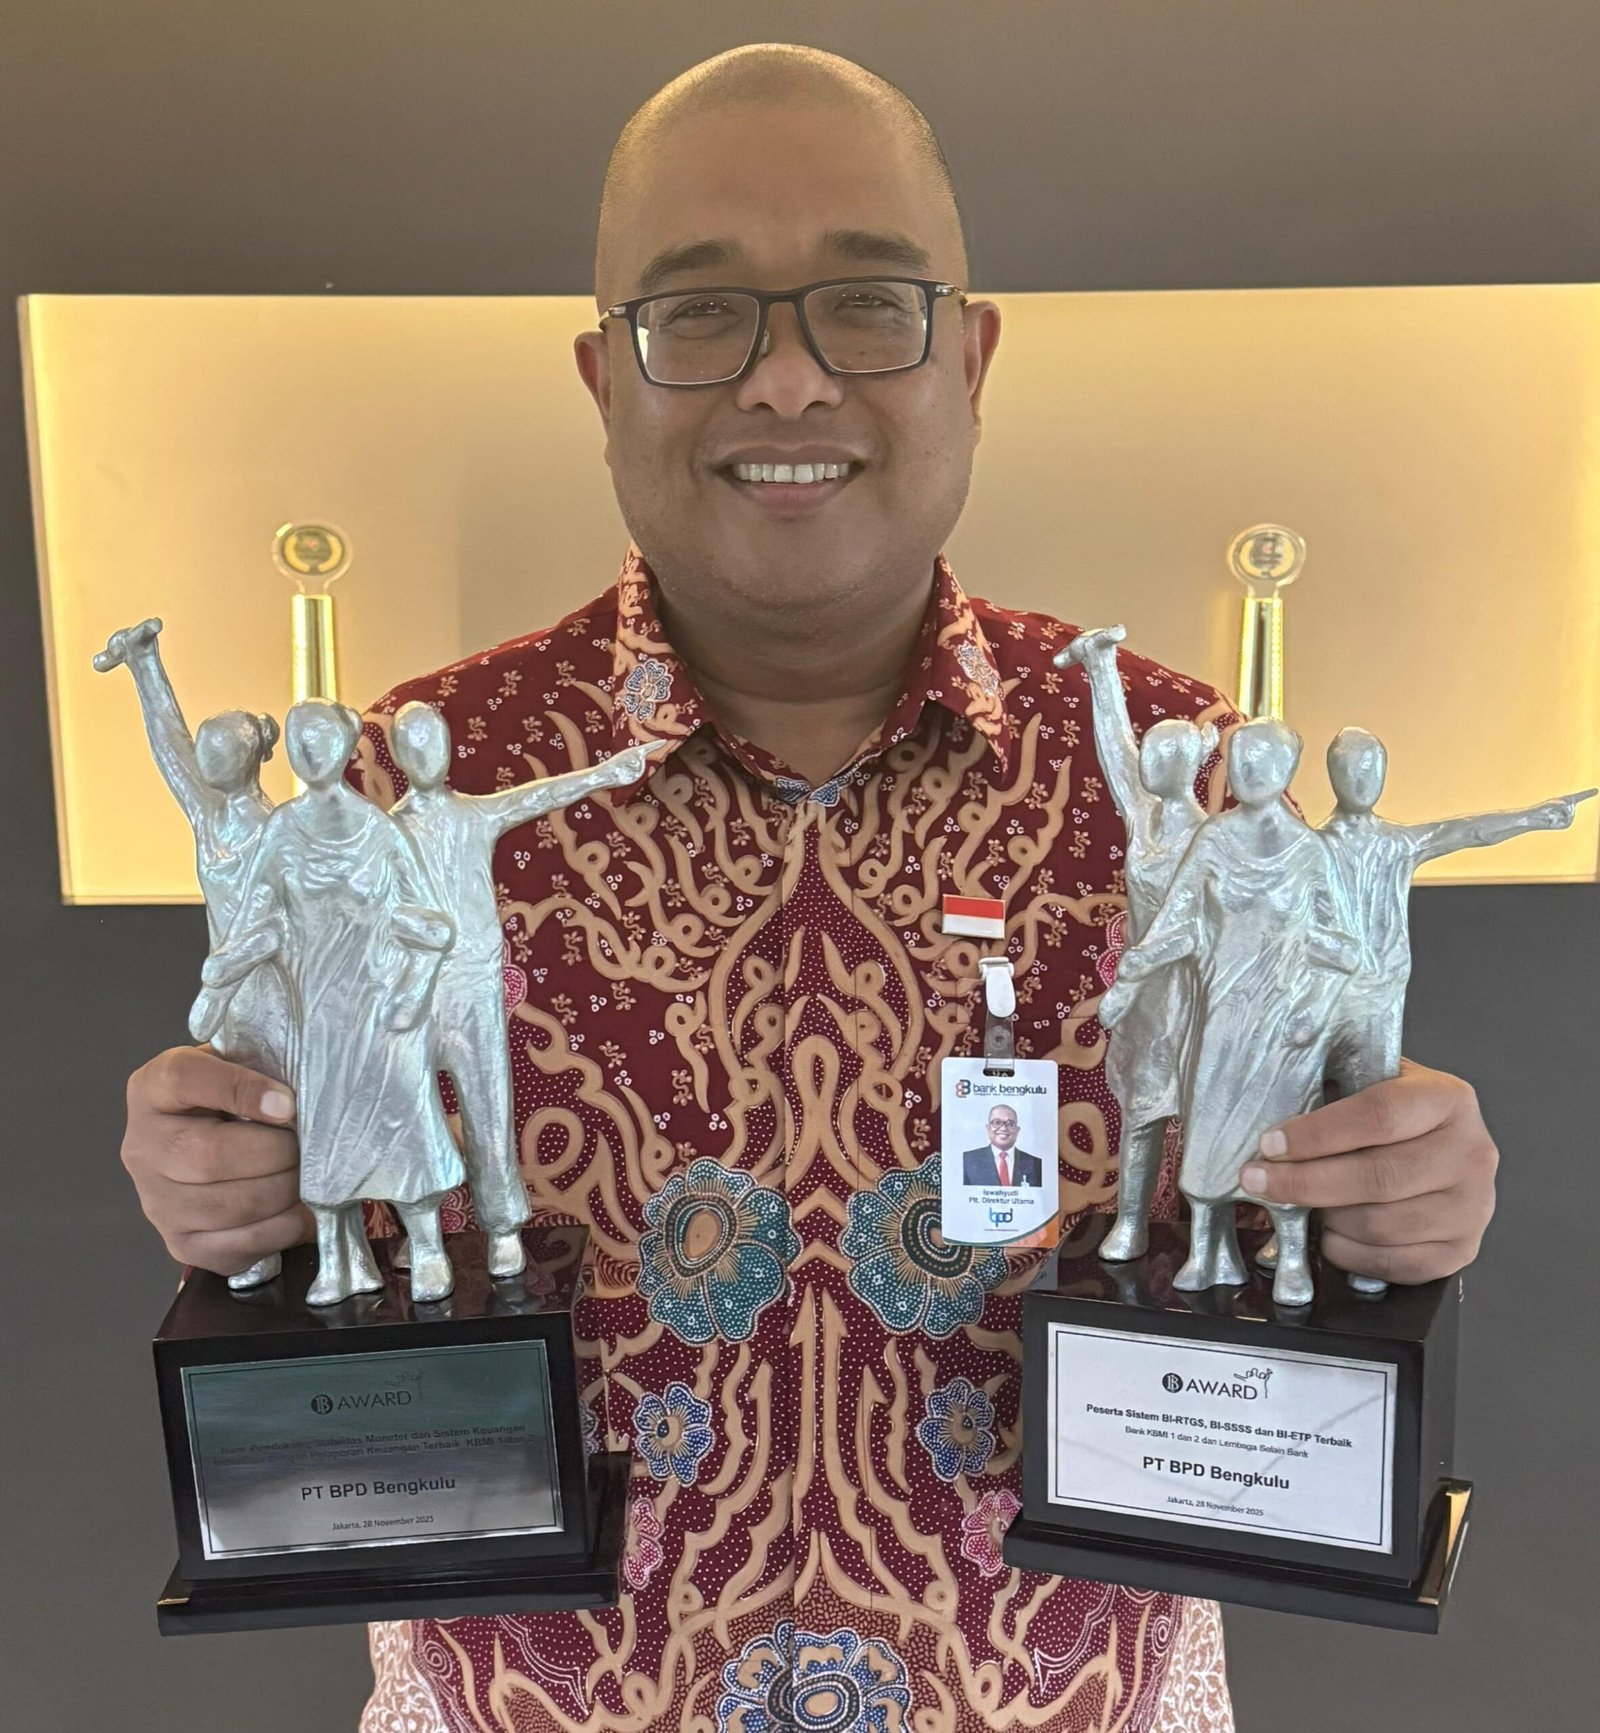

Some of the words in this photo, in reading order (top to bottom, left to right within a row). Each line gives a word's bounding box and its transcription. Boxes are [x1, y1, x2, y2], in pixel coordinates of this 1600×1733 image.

[973, 1083, 997, 1093] bank
[999, 1084, 1047, 1096] bengkulu
[982, 1197, 1010, 1205] Direktur
[983, 1189, 1019, 1198] Iswahyudi
[989, 1207, 1013, 1228] bpd
[1185, 1377, 1258, 1400] AWARD
[337, 1391, 412, 1410] AWARD
[365, 1433, 408, 1444] Moneter
[411, 1430, 431, 1440] dan
[434, 1429, 470, 1439] Sistem
[472, 1424, 526, 1436] Keuangan
[1086, 1403, 1124, 1417] Peserta
[1125, 1408, 1160, 1422] Sistem
[1161, 1412, 1208, 1429] BI-RTGS,
[1210, 1419, 1253, 1434] BI-SSSS
[1255, 1425, 1275, 1437] dan
[1276, 1428, 1312, 1442] BI-ETP
[1314, 1433, 1352, 1448] Terbaik
[366, 1444, 420, 1457] Keuangan
[1125, 1425, 1145, 1436] Bank
[1146, 1428, 1169, 1439] KBMI
[1171, 1431, 1175, 1440] 1
[1177, 1433, 1193, 1443] dan
[1194, 1435, 1200, 1444] 2
[1201, 1436, 1217, 1446] dan
[1219, 1438, 1258, 1452] Lembaga
[1259, 1442, 1285, 1455] Selain
[1287, 1447, 1309, 1458] Bank
[1143, 1456, 1164, 1472] PT
[1169, 1459, 1205, 1477] BPD
[1210, 1465, 1290, 1489] Bengkulu
[301, 1486, 324, 1501] PT
[329, 1482, 368, 1499] BPD
[373, 1477, 456, 1496] Bengkulu
[1166, 1496, 1194, 1507] Jakarta,
[1195, 1499, 1205, 1508] 28
[1206, 1501, 1244, 1514] November
[1245, 1507, 1264, 1517] 2025
[332, 1521, 362, 1531] Jakarta,
[374, 1517, 414, 1528] November
[415, 1514, 434, 1524] 2025
